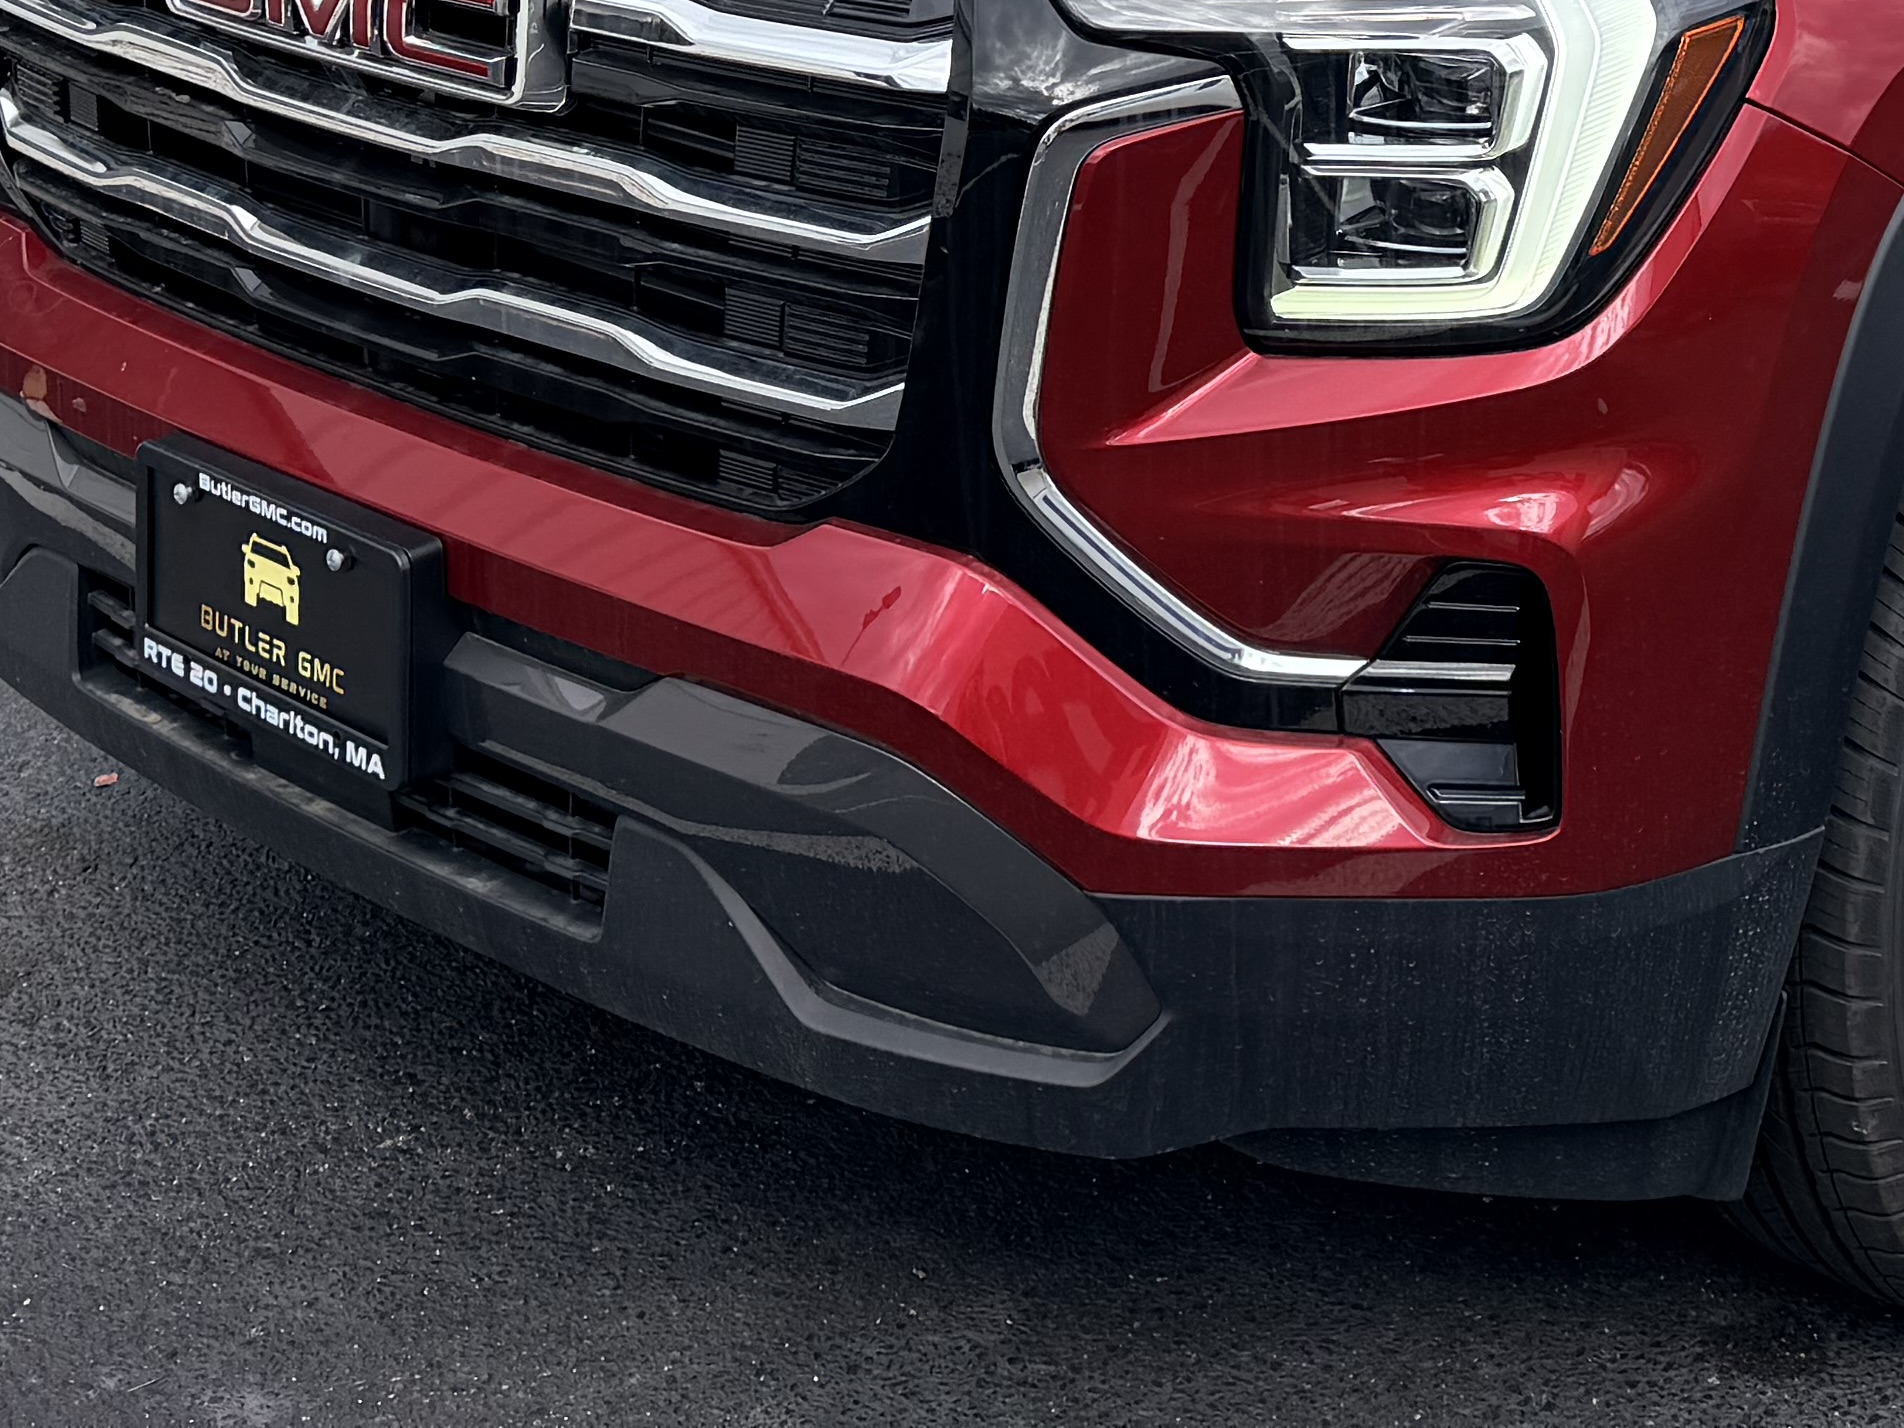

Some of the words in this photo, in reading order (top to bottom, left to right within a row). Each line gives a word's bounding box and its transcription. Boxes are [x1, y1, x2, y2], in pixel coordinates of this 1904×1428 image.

[198, 471, 328, 544] ButlerGMC.com
[200, 603, 286, 668] BUTLER
[297, 650, 345, 695] GMC
[214, 646, 230, 662] AT
[235, 654, 267, 680] YOUR
[272, 673, 328, 710] SERVICE
[143, 636, 185, 678] RTE
[190, 660, 218, 695] 20
[237, 685, 340, 761] Charlton,
[345, 739, 386, 780] MA
